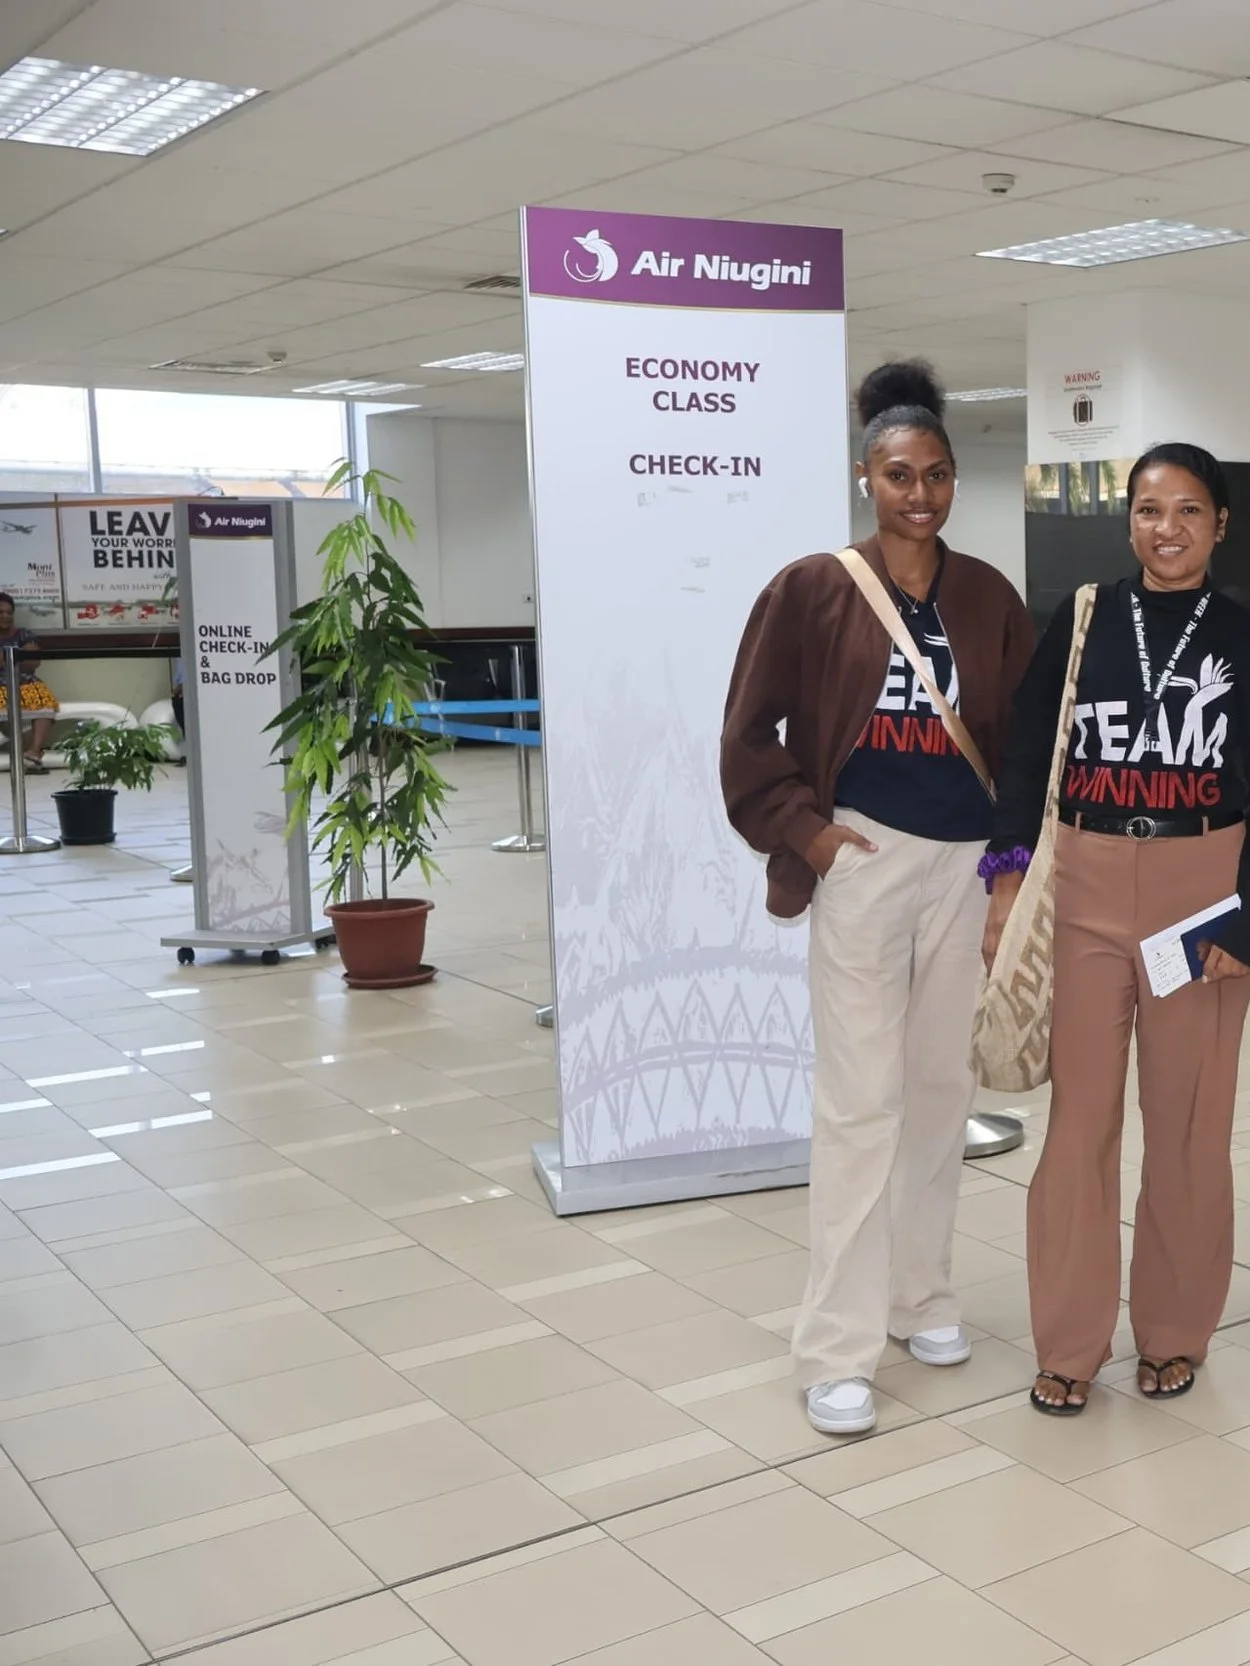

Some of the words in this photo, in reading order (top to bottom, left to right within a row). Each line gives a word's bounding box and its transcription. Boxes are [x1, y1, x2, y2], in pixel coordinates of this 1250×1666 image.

[630, 250, 685, 278] Air
[693, 254, 812, 291] Niugini
[625, 357, 761, 383] ECONOMY
[1064, 370, 1101, 384] WARNING
[652, 390, 737, 413] CLASS
[628, 454, 762, 477] CHECK-IN
[89, 510, 171, 537] LEAV
[214, 517, 230, 527] Air
[231, 517, 266, 529] Niugini
[91, 537, 129, 548] YOUR
[93, 549, 174, 569] BEHIN
[198, 624, 253, 638] ONLINE
[199, 641, 270, 654] CHECK-IN
[200, 655, 211, 669] &
[201, 672, 231, 685] BAG
[235, 672, 277, 686] DROP
[875, 653, 959, 715] EA
[1074, 700, 1228, 769] TEAM
[1066, 765, 1222, 810] WINNING
